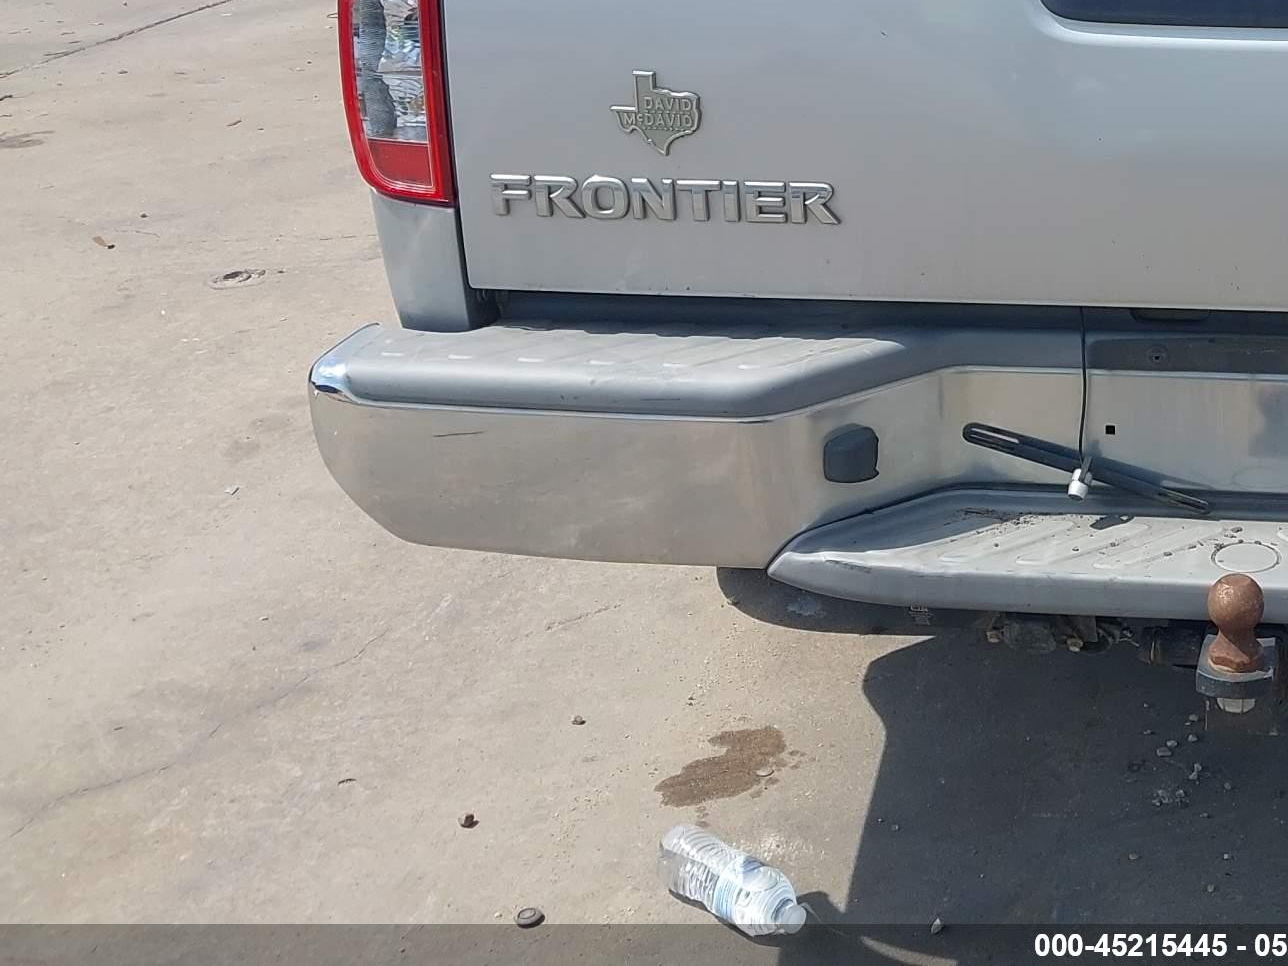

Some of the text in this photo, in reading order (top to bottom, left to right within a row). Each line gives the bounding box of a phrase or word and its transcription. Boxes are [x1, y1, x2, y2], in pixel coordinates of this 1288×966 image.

[643, 96, 692, 111] DAVID
[623, 111, 693, 127] McDAVID
[489, 173, 842, 225] FRONTIER
